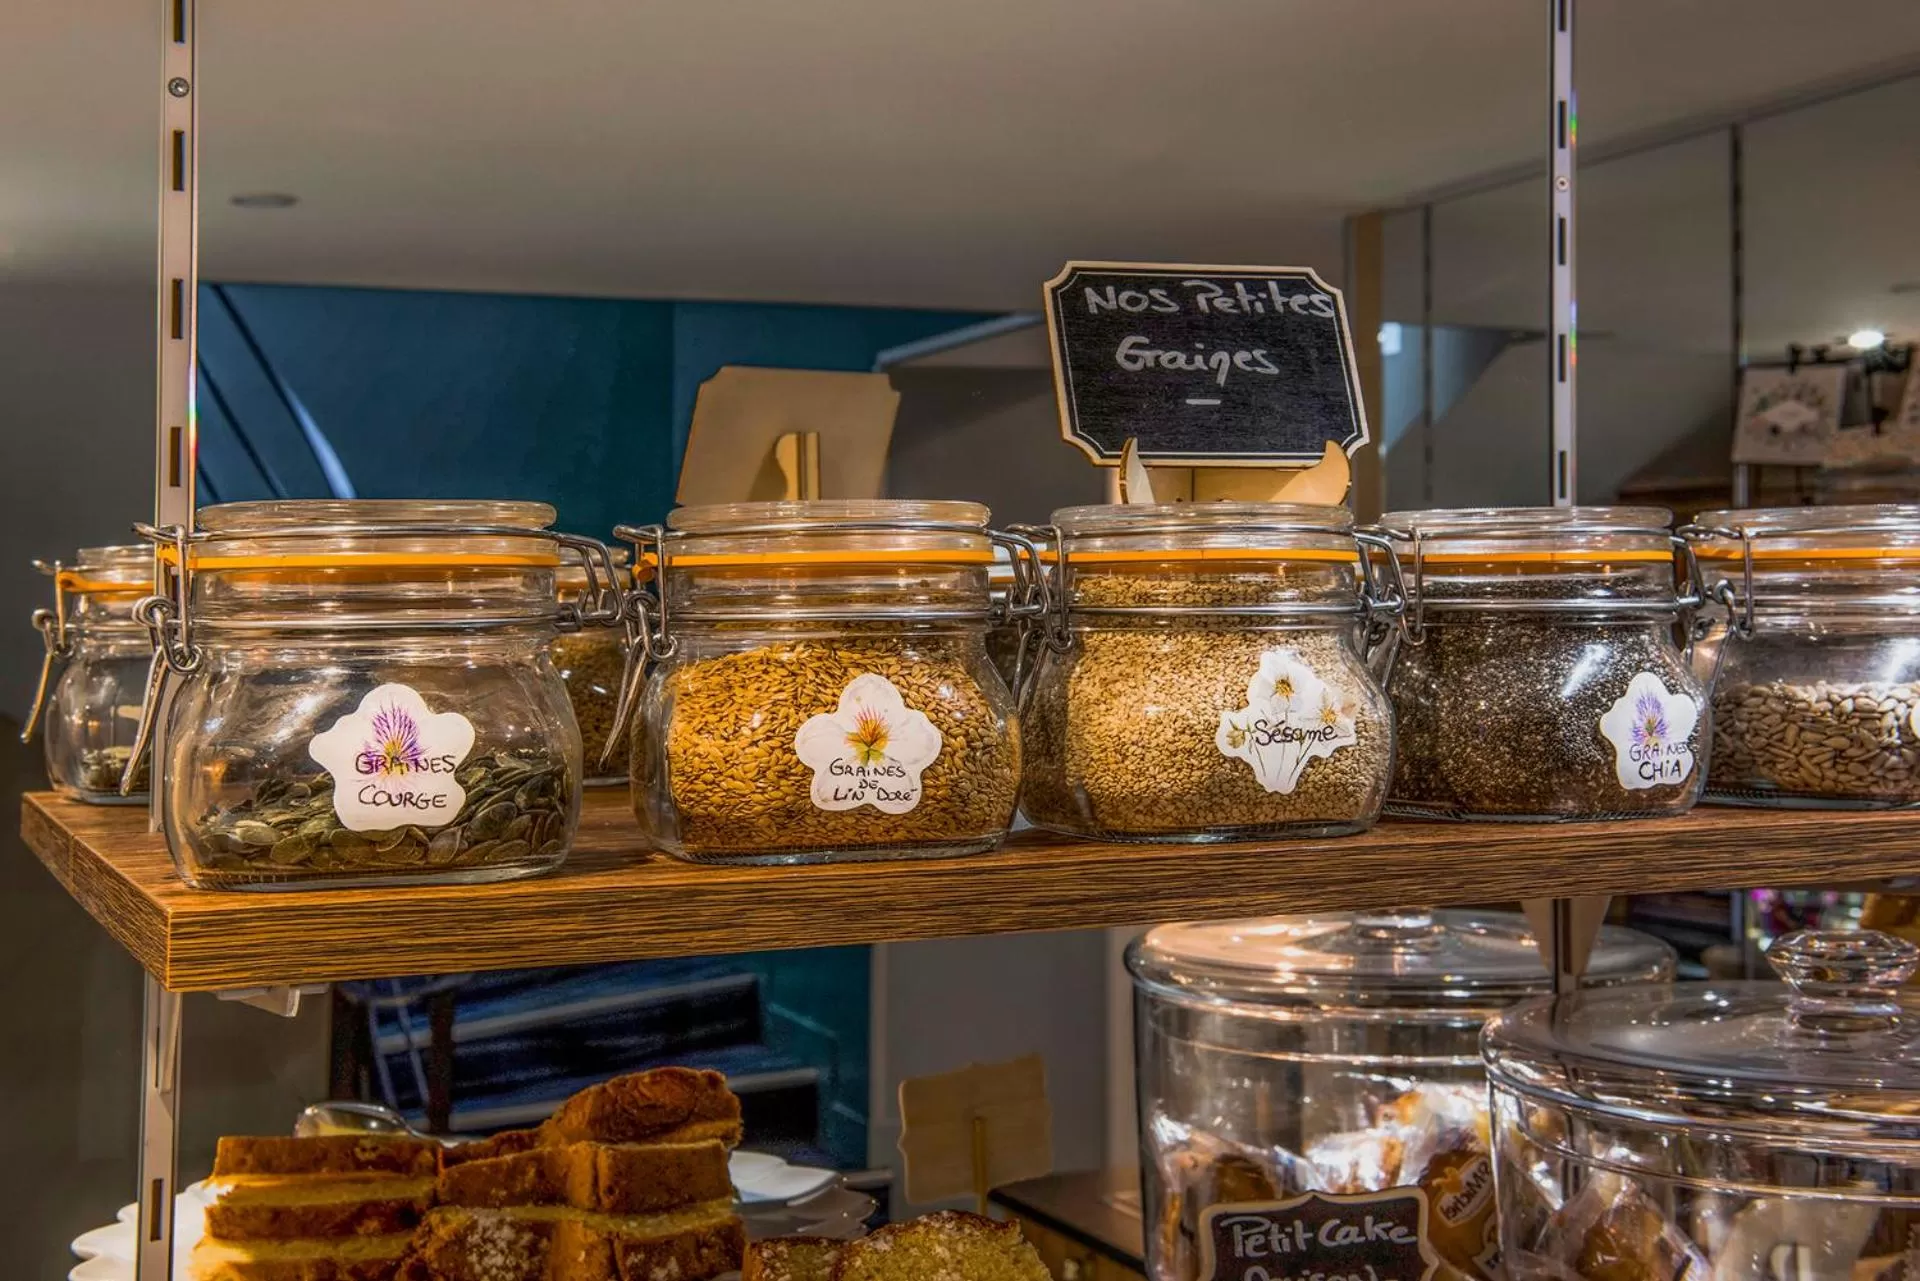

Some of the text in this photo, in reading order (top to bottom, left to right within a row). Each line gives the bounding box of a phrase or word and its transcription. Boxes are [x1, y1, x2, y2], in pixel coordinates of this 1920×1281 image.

[1181, 279, 1336, 318] Petites
[1254, 719, 1338, 746] Sésame
[358, 784, 448, 810] COURGE
[1220, 1215, 1418, 1258] Petit Cake
